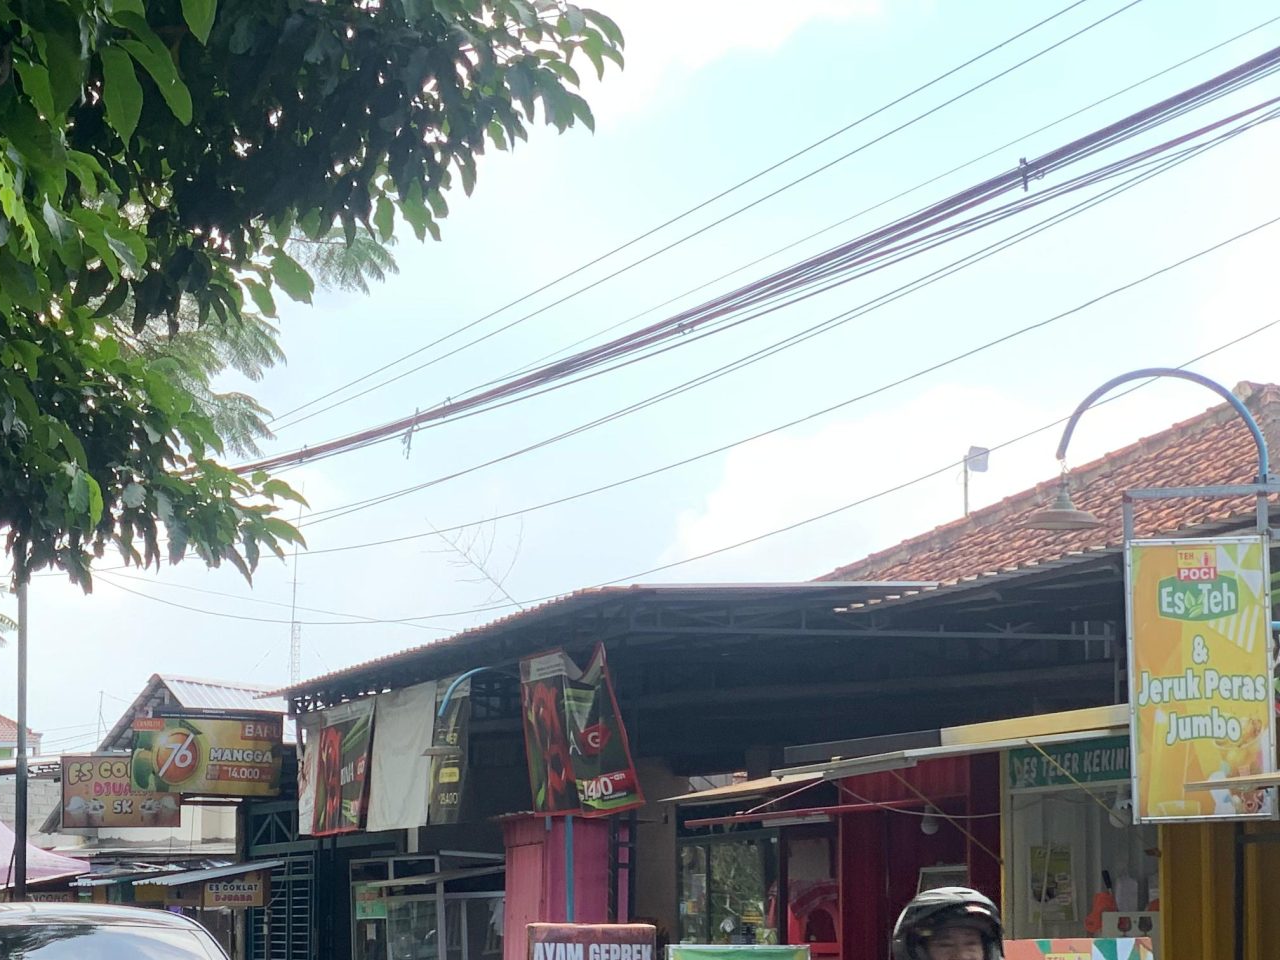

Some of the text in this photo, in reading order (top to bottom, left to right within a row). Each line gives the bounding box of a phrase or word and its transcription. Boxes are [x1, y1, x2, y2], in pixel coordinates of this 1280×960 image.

[1178, 552, 1194, 560] TEH
[1180, 568, 1215, 580] POCI
[1161, 582, 1236, 614] Es Teh
[1192, 635, 1209, 664] &
[1138, 668, 1266, 706] Jeruk Peras
[1166, 707, 1241, 745] Jumbo
[210, 748, 273, 763] MANGGA
[1023, 757, 1038, 779] ES
[1042, 754, 1079, 777] TELER
[68, 761, 131, 785] ES CO
